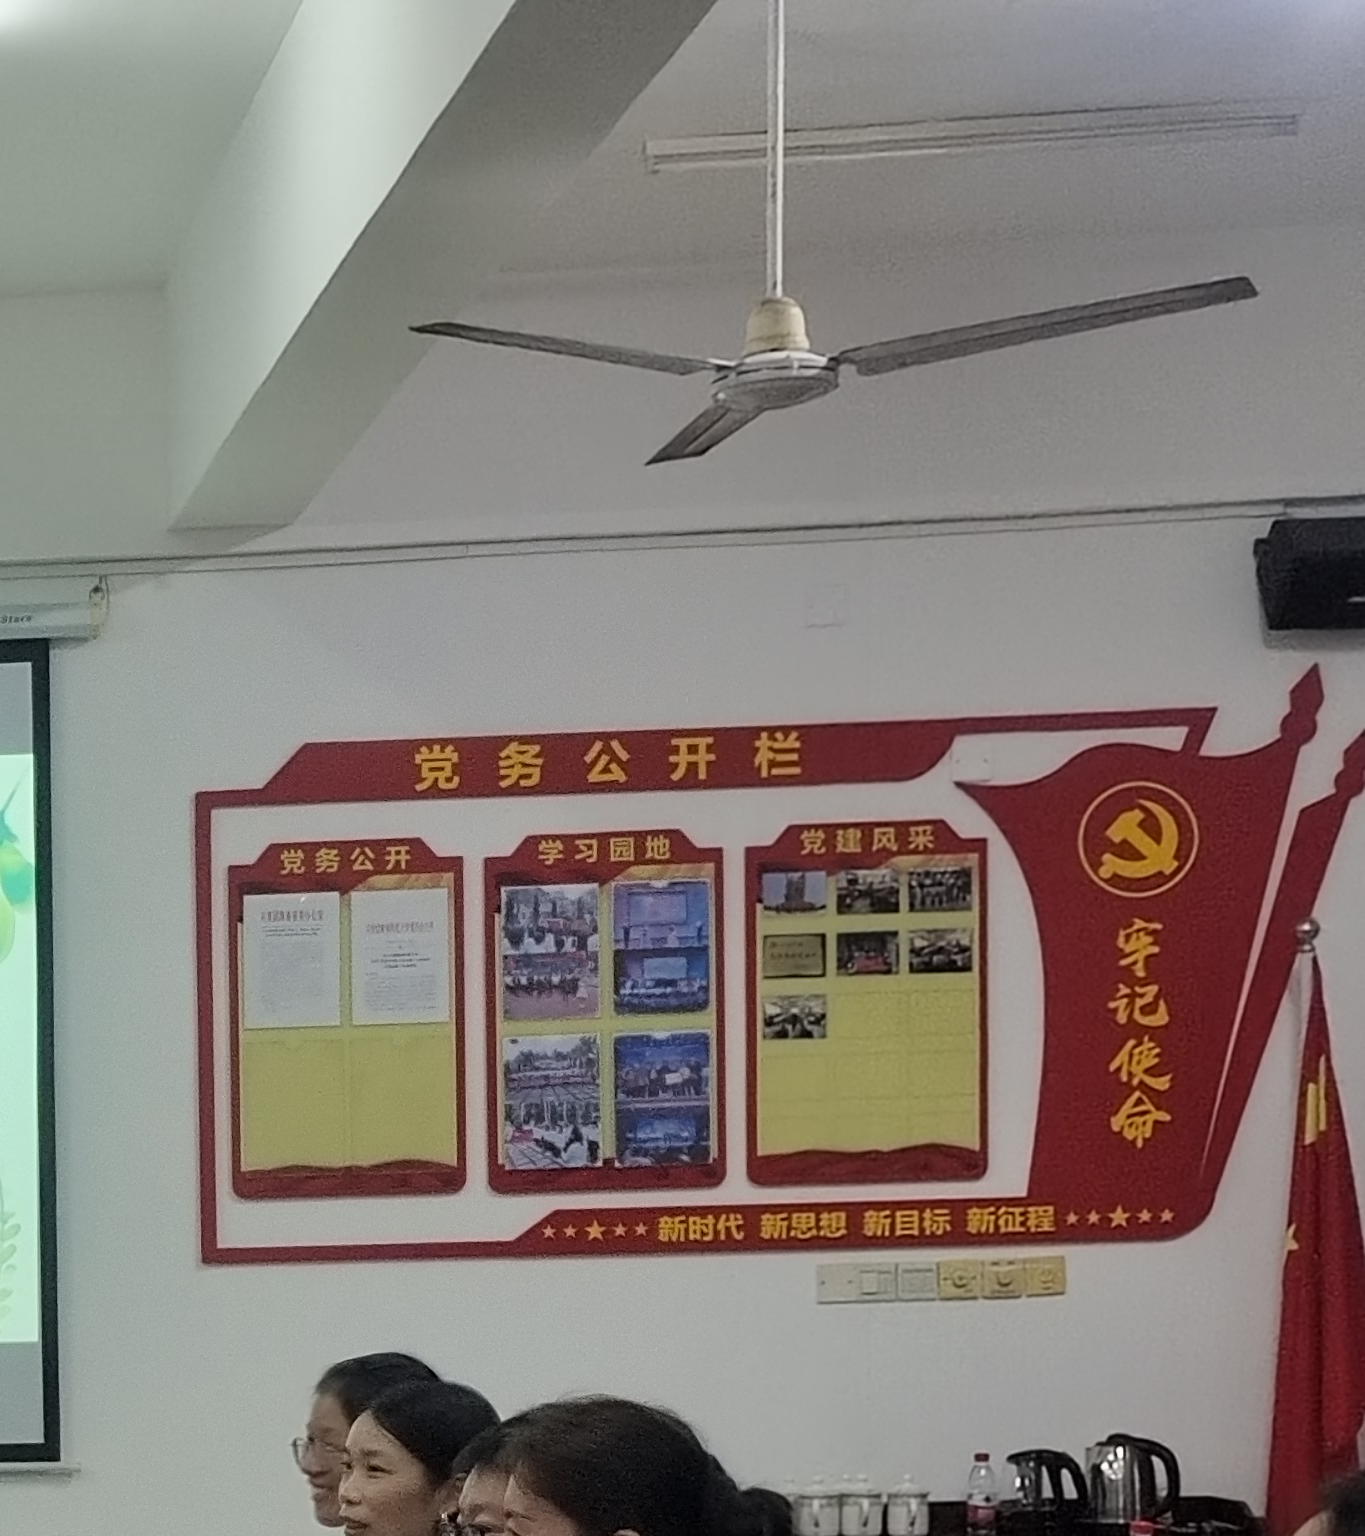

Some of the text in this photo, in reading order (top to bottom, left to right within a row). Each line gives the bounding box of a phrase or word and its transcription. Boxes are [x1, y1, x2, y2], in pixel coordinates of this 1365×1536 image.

[413, 731, 802, 793] 党务公开栏
[537, 834, 671, 865] 学习园地
[799, 827, 936, 855] 党建风采
[279, 845, 412, 875] 党务公开
[1107, 918, 1174, 1149] 牢记使命
[657, 1206, 1057, 1244] 新时代 新思想 新目标 新征程
